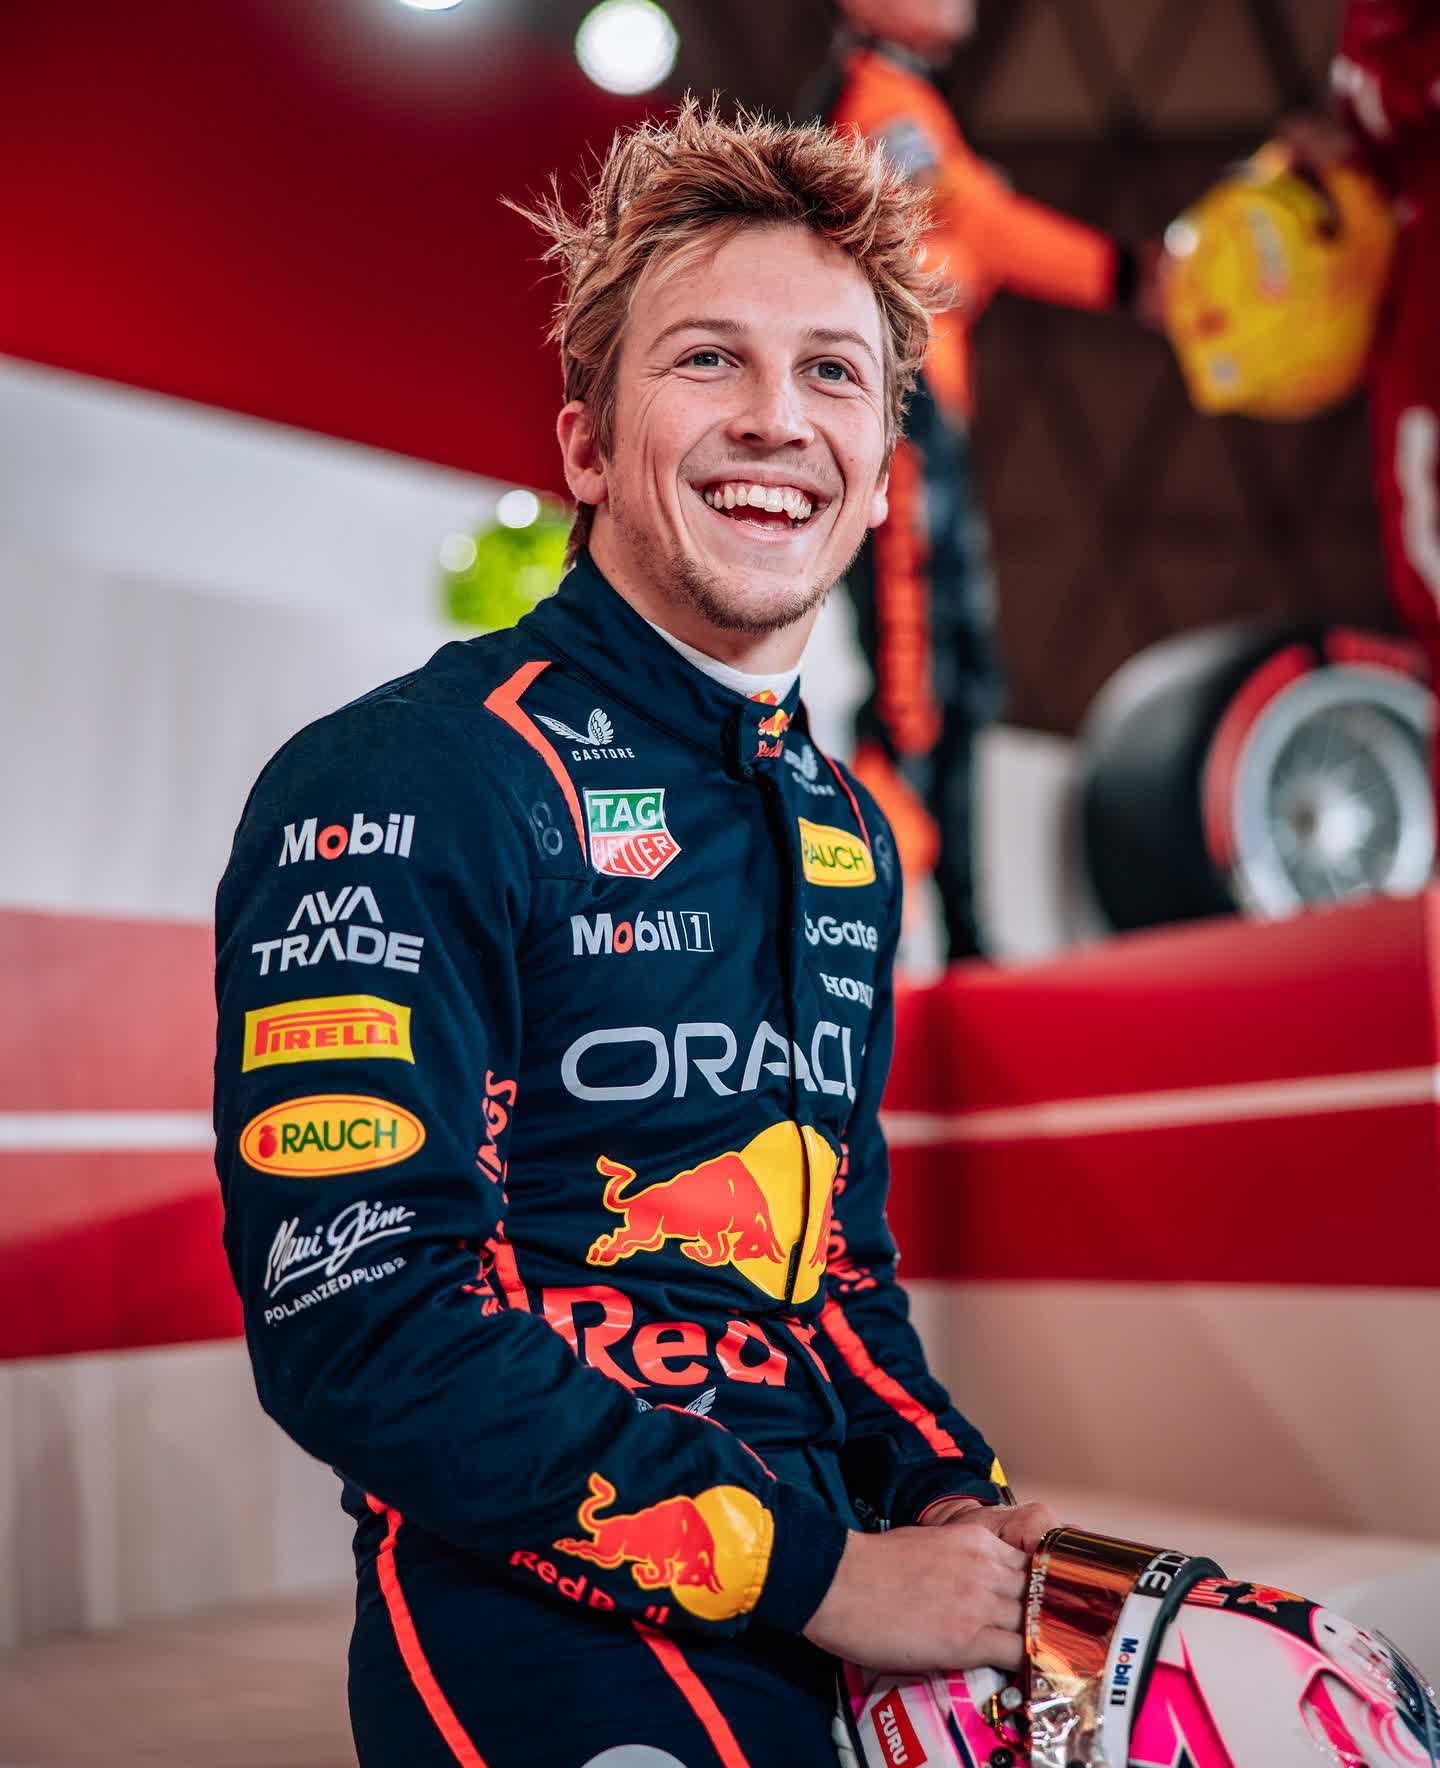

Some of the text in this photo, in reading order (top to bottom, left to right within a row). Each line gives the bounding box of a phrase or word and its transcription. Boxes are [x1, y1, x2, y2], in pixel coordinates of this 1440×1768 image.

[571, 747, 635, 761] CASTORE
[592, 796, 655, 829] TAG
[278, 813, 416, 868] Mobil
[593, 835, 673, 875] HEUER
[286, 886, 384, 932] AVA
[251, 925, 425, 977] TRADE
[570, 911, 681, 956] Mobil
[819, 972, 874, 1011] HON
[254, 1008, 399, 1057] PIRELLI
[560, 1019, 866, 1105] ORACL
[281, 1118, 398, 1155] RAUCH
[509, 1550, 589, 1602] Red
[1113, 1638, 1139, 1686] Mobil
[878, 1703, 909, 1766] ZURU
